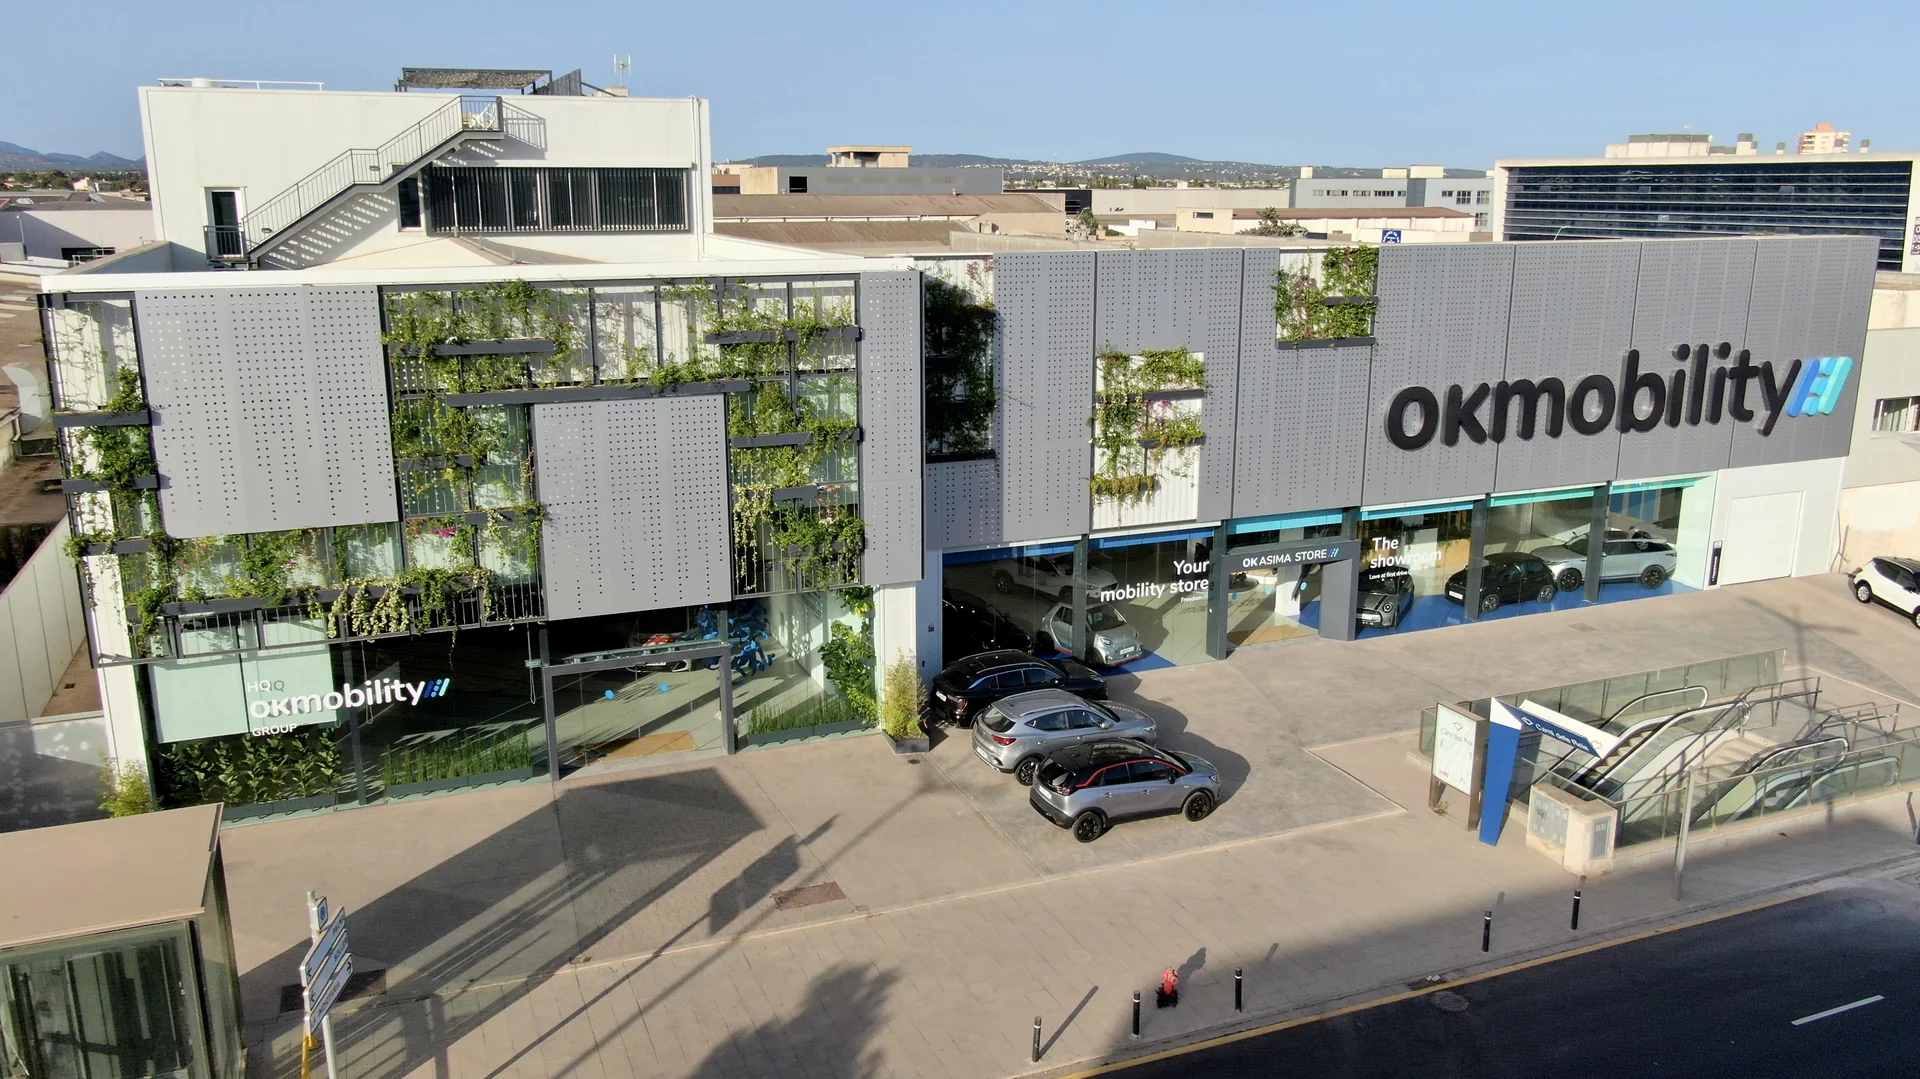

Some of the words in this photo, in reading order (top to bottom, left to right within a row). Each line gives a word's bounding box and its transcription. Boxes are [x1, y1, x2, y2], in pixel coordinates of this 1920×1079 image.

[1372, 536, 1399, 552] The
[1294, 548, 1327, 562] STORE
[1370, 550, 1442, 569] showroom
[1173, 560, 1210, 575] Your
[1100, 581, 1166, 602] mobility
[1169, 578, 1209, 594] store
[247, 679, 271, 693] HQ
[251, 723, 298, 737] GROUP
